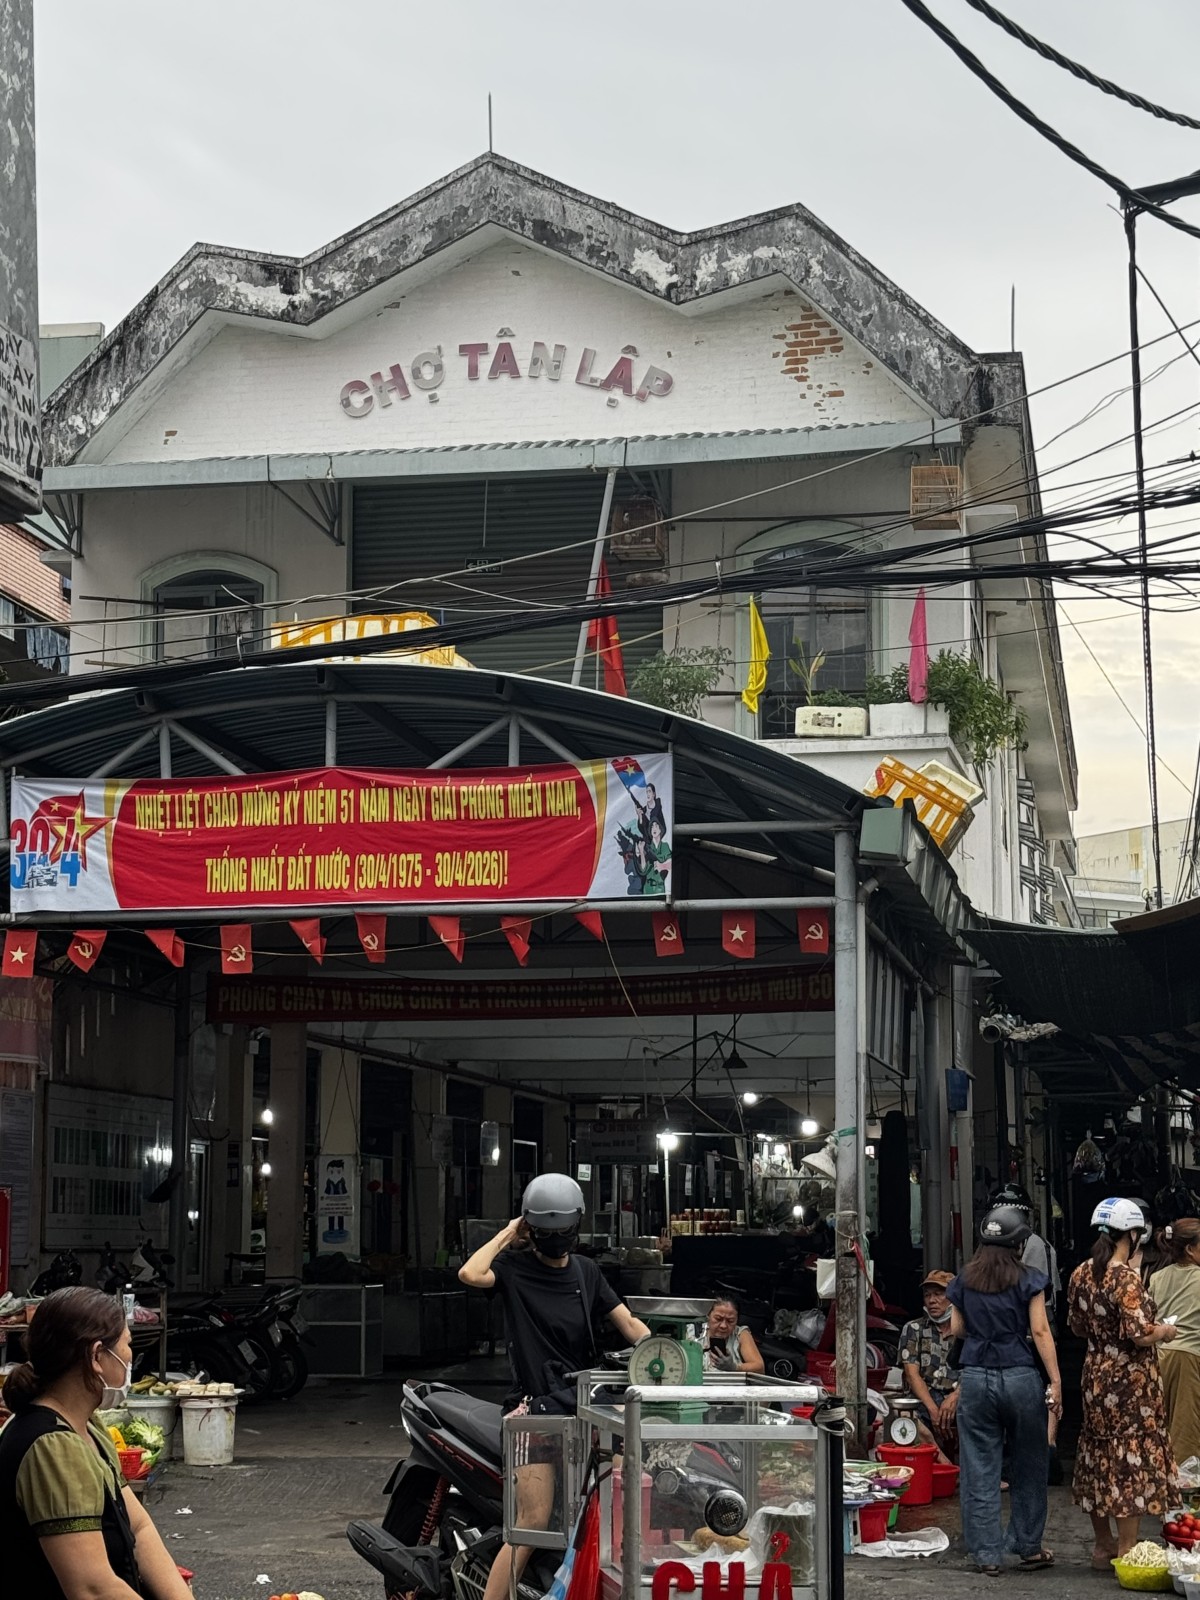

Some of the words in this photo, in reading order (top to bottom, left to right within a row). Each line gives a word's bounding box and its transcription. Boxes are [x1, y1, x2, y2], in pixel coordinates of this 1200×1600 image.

[340, 345, 445, 417] CHỢ
[459, 327, 566, 380] TÂN
[575, 345, 674, 408] LẬP
[135, 790, 171, 837] NHIỆT
[175, 788, 200, 837] LIỆT
[204, 786, 238, 829] CHÀO
[242, 784, 280, 827] MỪNG
[283, 778, 300, 826] KỶ
[304, 781, 337, 833] NIỆM
[340, 789, 354, 824] 51
[360, 780, 389, 823] NĂM
[393, 780, 426, 822] NGÀY
[431, 775, 457, 821] GIẢI
[460, 778, 504, 820] PHÓNG
[507, 772, 542, 818] MIỀN
[545, 780, 581, 820] NAM,
[205, 845, 247, 893] THỐNG
[250, 843, 284, 892] NHẤT
[287, 842, 312, 891] ĐẤT
[314, 847, 350, 890] NƯỚC
[354, 852, 422, 892] (30/4/1975
[425, 868, 431, 876] -
[435, 850, 508, 889] 30/4/2026)!
[217, 980, 276, 1012] PHÒNG
[282, 980, 325, 1011] CHÁY
